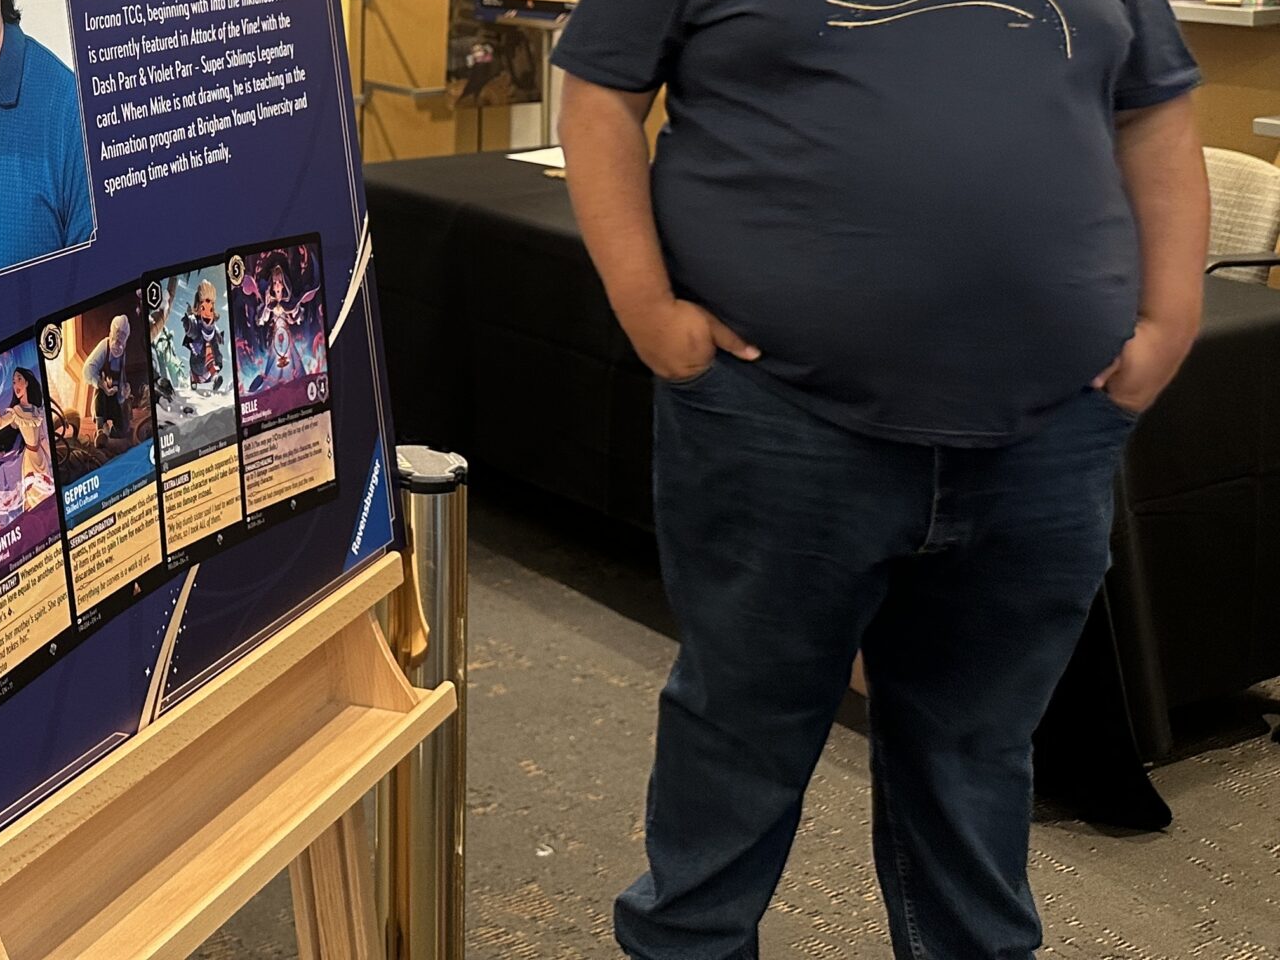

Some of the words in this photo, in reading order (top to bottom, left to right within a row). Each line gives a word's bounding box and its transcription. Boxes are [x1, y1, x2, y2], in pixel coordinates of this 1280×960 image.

[84, 11, 122, 31] Lorcana
[121, 4, 146, 26] TCG,
[146, 0, 190, 24] beginning
[87, 44, 97, 64] is
[98, 36, 140, 62] currently
[141, 29, 179, 54] featured
[179, 29, 189, 47] in
[189, 23, 217, 45] Attack
[217, 21, 226, 44] of
[225, 20, 240, 39] the
[240, 15, 261, 36] Vine!
[260, 13, 278, 32] with
[277, 11, 291, 29] the
[91, 73, 117, 96] Dash
[117, 71, 137, 91] Parr
[138, 66, 147, 87] &
[146, 63, 175, 84] Violet
[174, 60, 193, 79] Parr
[200, 54, 225, 76] Super
[225, 48, 257, 68] Siblings
[256, 40, 294, 64] Legendary
[96, 105, 121, 128] card.
[120, 101, 149, 122] When
[149, 94, 172, 116] Mike
[172, 92, 181, 110] is
[181, 90, 198, 108] not
[197, 83, 233, 105] drawing,
[232, 79, 244, 96] he
[243, 76, 252, 94] is
[252, 71, 285, 92] teaching
[284, 68, 293, 84] in
[292, 65, 306, 83] the
[100, 133, 148, 161] Animation
[148, 127, 186, 153] program
[187, 121, 197, 138] at
[196, 113, 232, 137] Brigham
[230, 108, 257, 127] Young
[256, 97, 293, 120] University
[293, 91, 308, 111] and
[103, 167, 147, 197] spending
[147, 161, 169, 181] time
[169, 152, 189, 174] with
[189, 149, 203, 169] his
[203, 141, 232, 165] family.
[151, 288, 157, 301] 2
[48, 335, 54, 348] 5
[241, 399, 258, 415] BELLE
[161, 433, 174, 449] LILO
[65, 475, 99, 504] GEPPETTO
[351, 458, 381, 556] Ravensburger
[20, 558, 43, 580] Whenever
